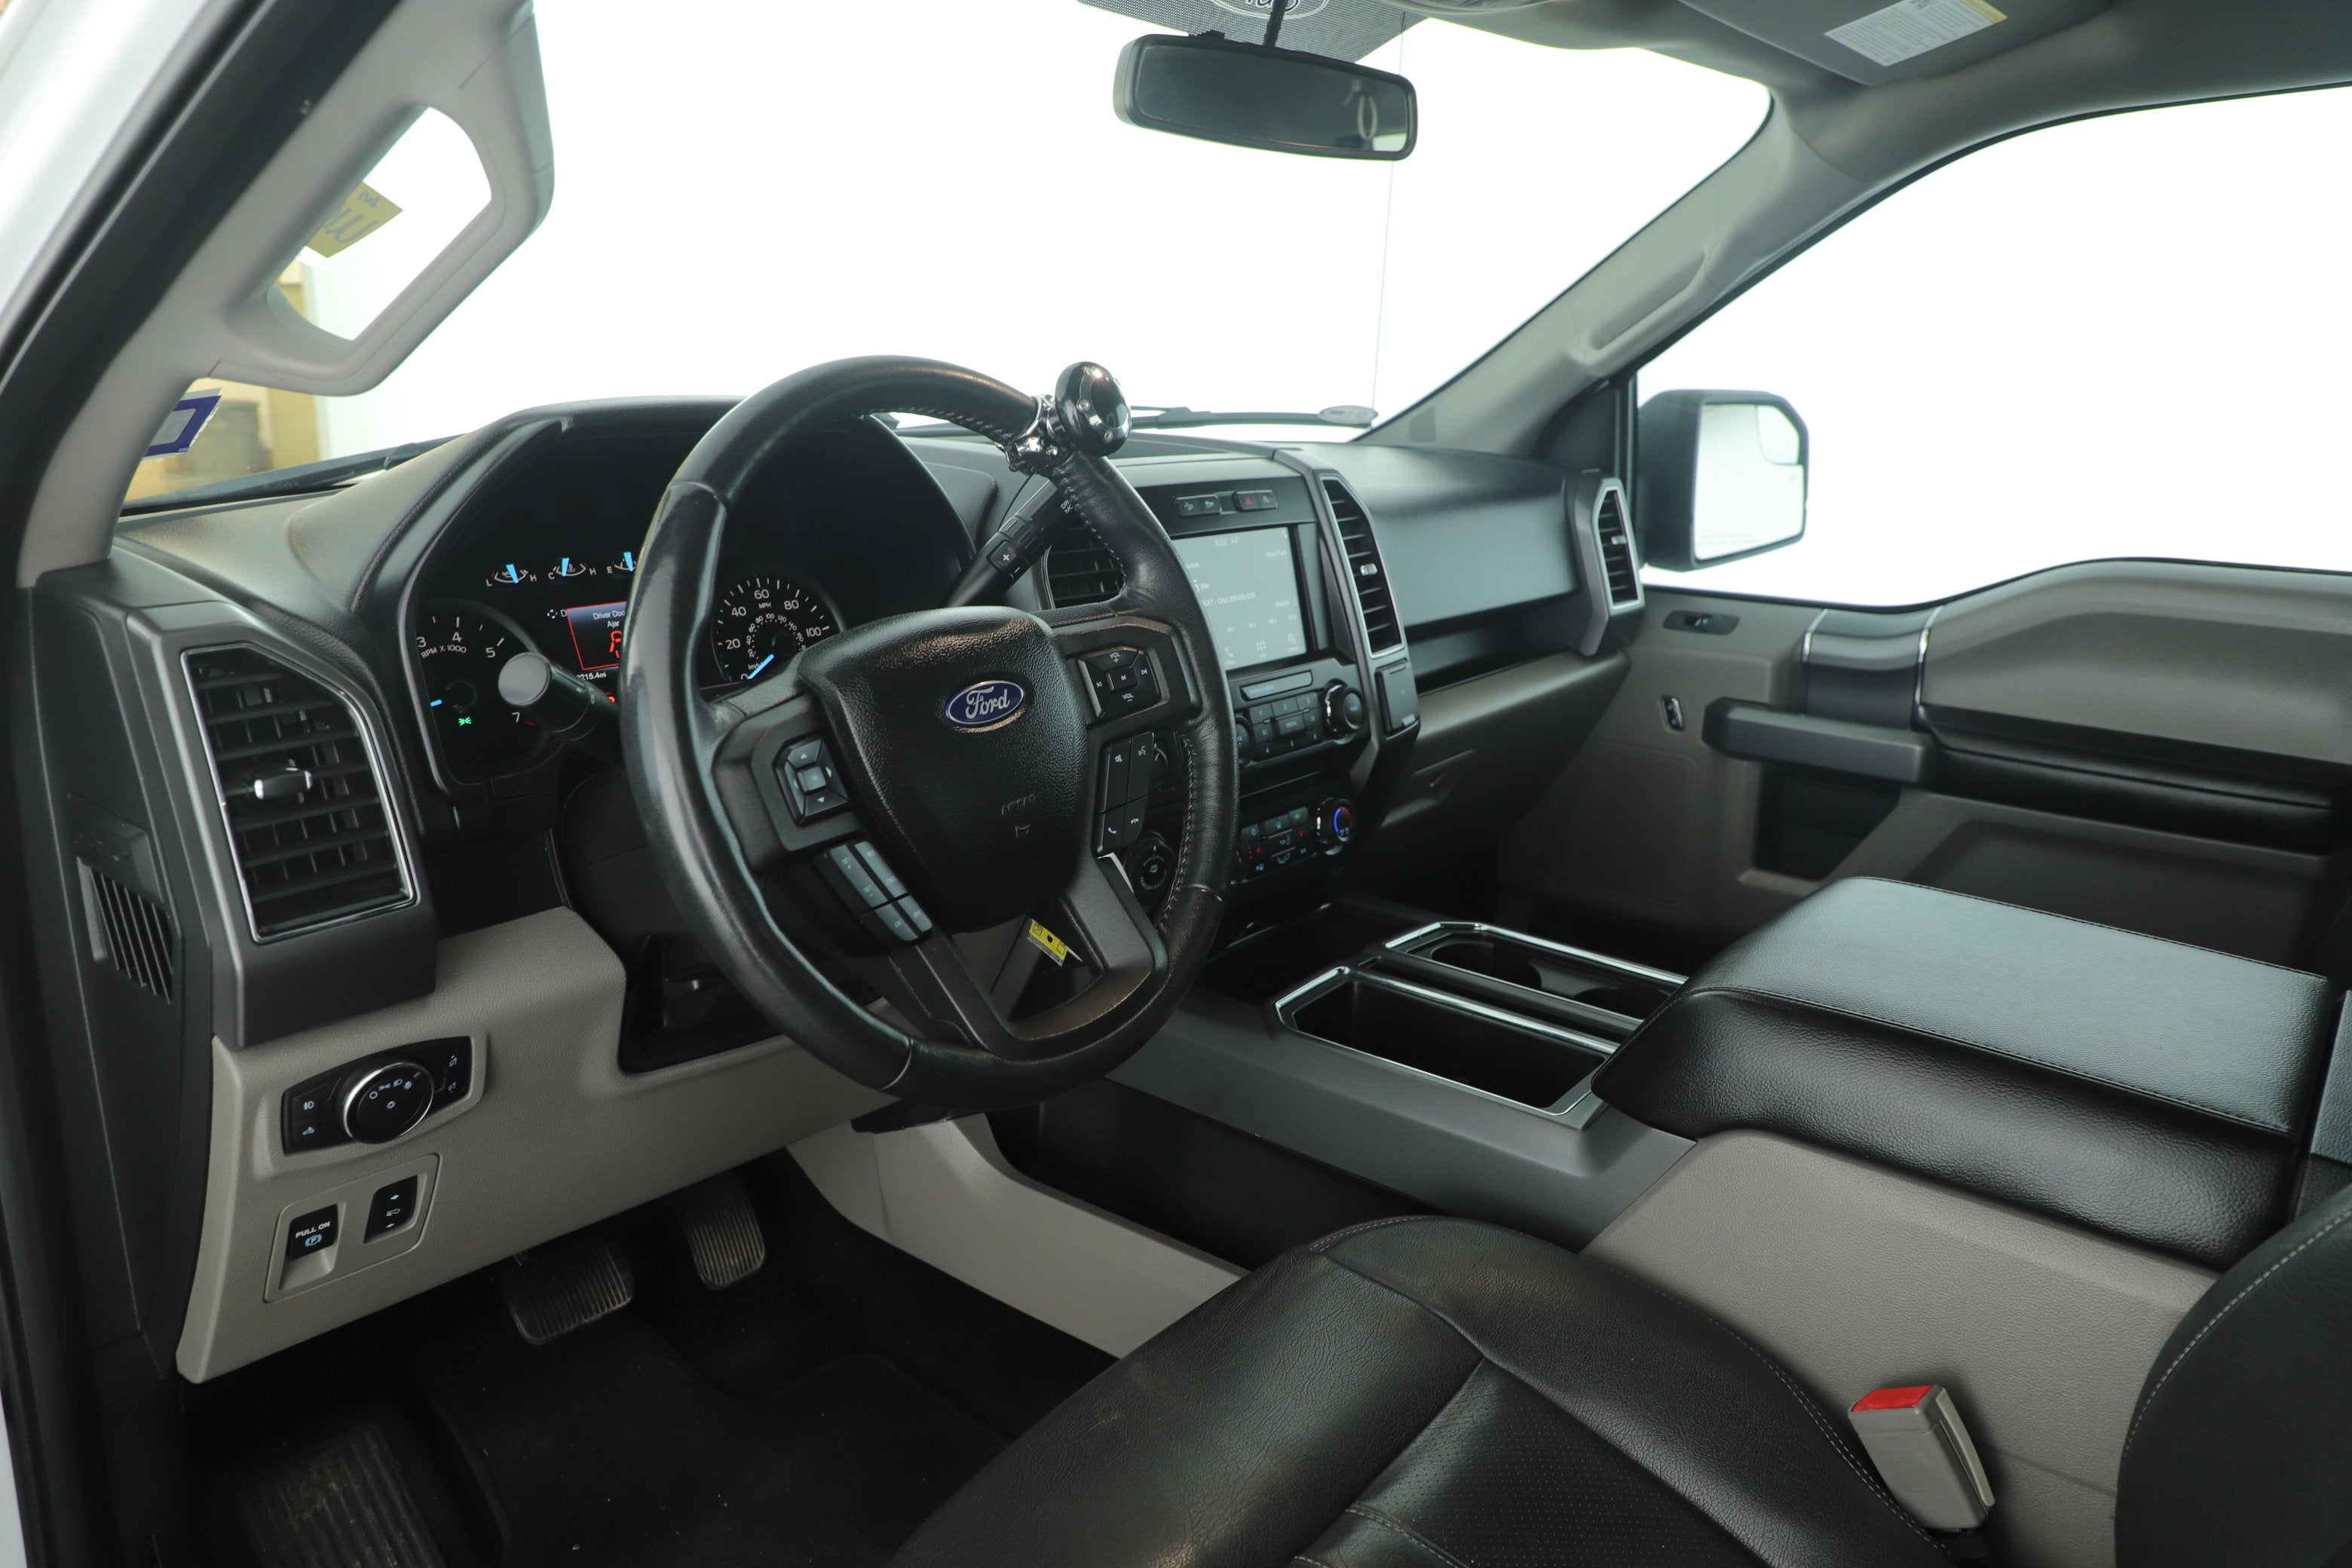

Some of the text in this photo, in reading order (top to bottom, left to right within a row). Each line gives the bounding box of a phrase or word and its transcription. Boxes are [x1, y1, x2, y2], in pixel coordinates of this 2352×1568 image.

[548, 571, 555, 580] C
[754, 589, 770, 599] 60
[784, 599, 800, 610] 80
[593, 611, 611, 620] Driver
[731, 606, 747, 617] 40
[607, 620, 620, 629] Ajar
[452, 632, 462, 642] 4
[806, 627, 822, 638] 100
[416, 636, 427, 648] 3
[725, 639, 741, 650] 20
[421, 647, 438, 659] RPM
[447, 645, 467, 654] 1000
[485, 647, 496, 658] 5
[965, 685, 1010, 719] Ford
[511, 711, 520, 723] 7
[296, 1221, 330, 1239] PULL ON
